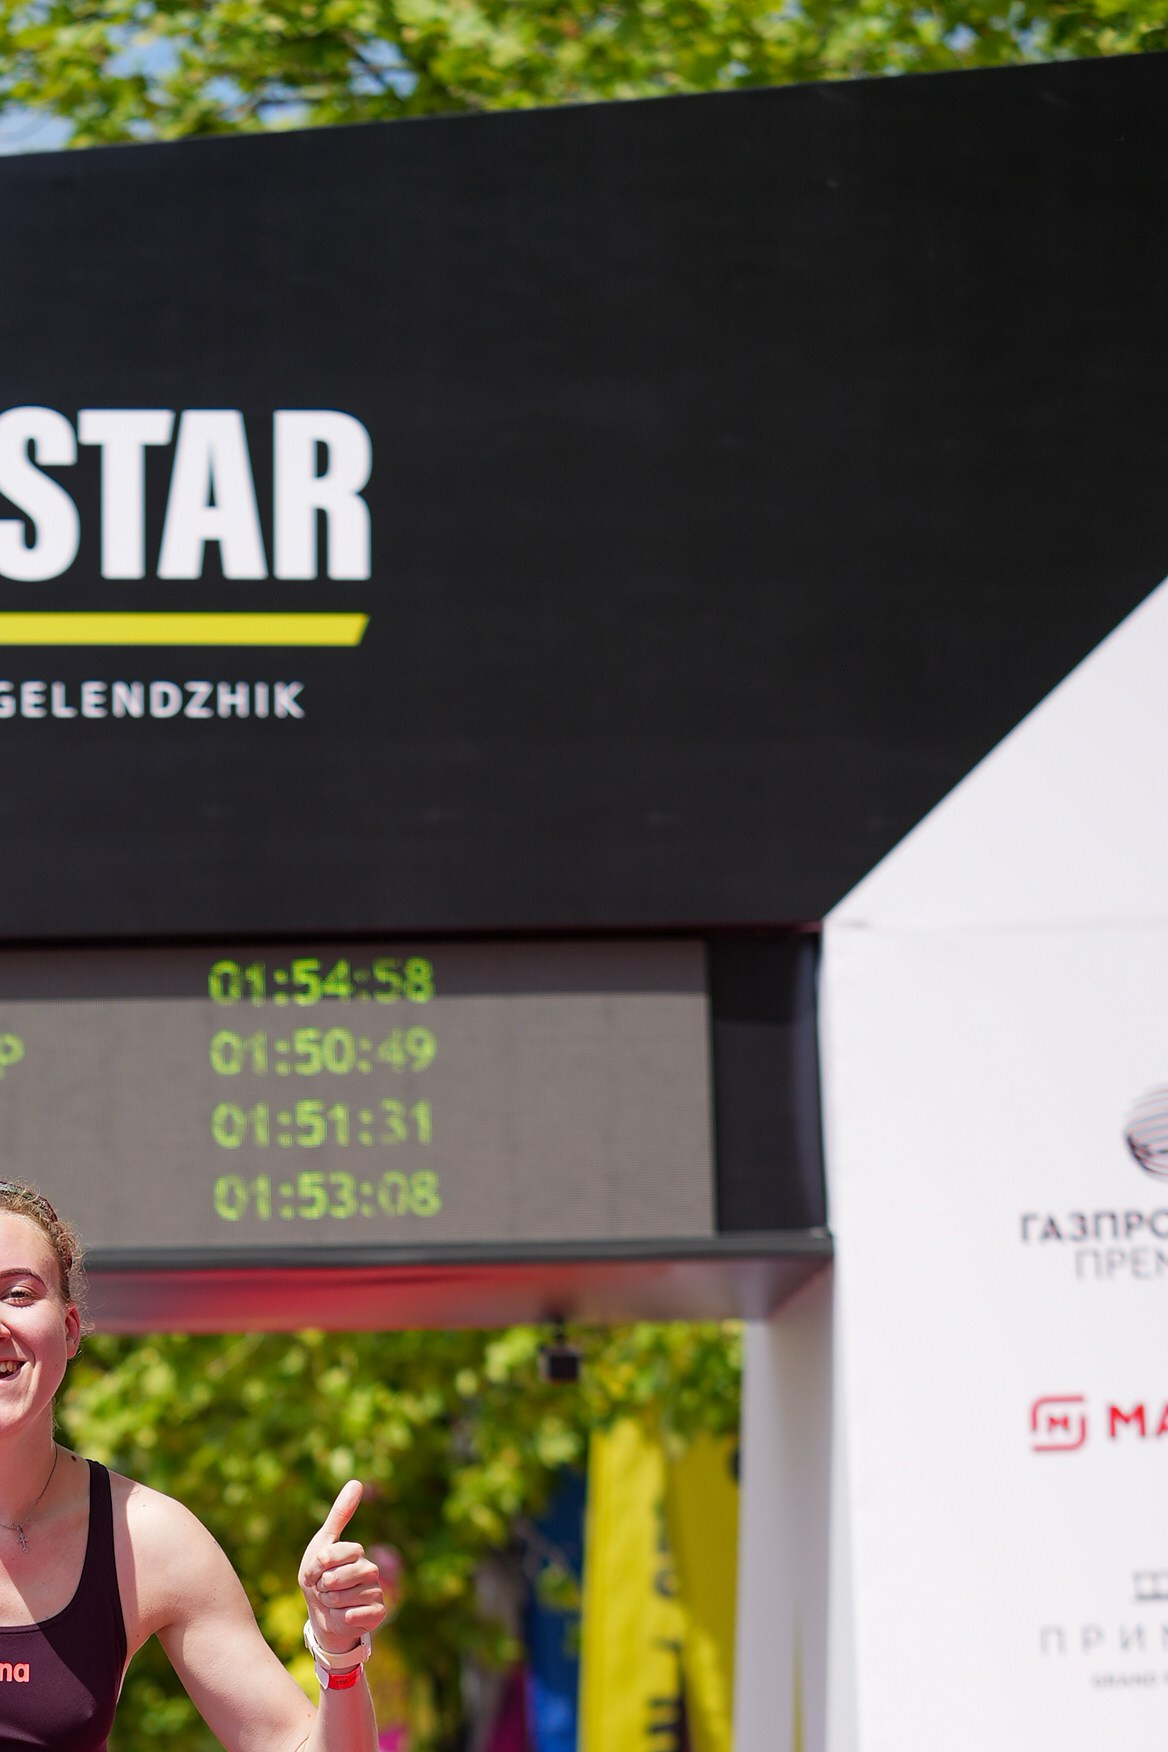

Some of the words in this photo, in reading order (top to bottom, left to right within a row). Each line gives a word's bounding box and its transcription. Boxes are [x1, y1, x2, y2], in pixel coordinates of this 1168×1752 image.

[208, 957, 434, 1007] 01:54:58
[209, 1026, 437, 1076] 01:50:49
[211, 1099, 434, 1149] 01:51:31
[213, 1170, 442, 1221] 01:53:08
